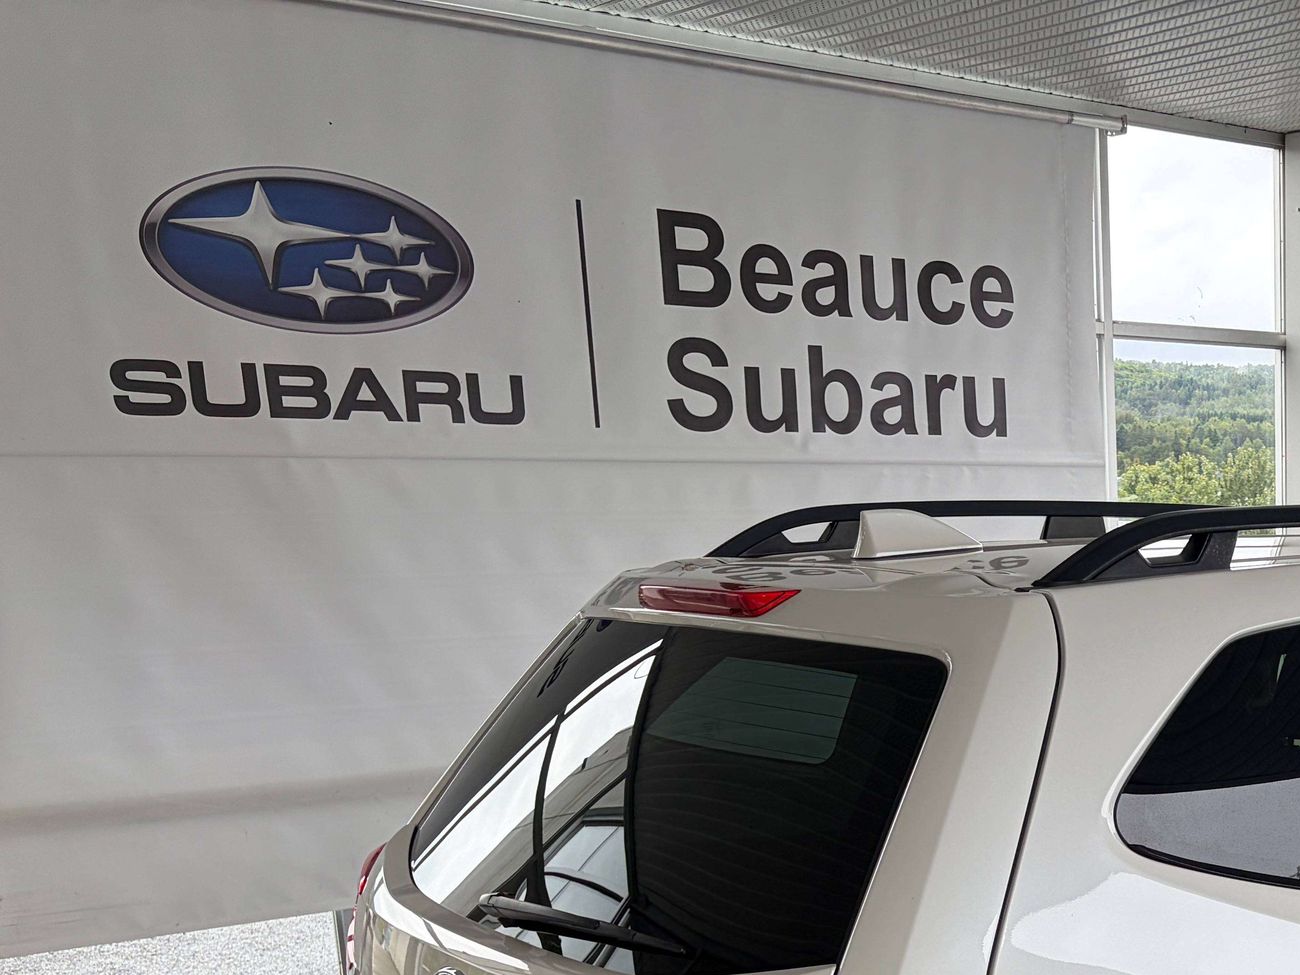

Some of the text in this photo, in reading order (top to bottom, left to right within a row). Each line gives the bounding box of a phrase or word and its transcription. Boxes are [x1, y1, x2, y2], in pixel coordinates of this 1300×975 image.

[657, 209, 1014, 328] Beauce
[110, 359, 526, 426] SUBARU
[667, 337, 1008, 438] Subaru
